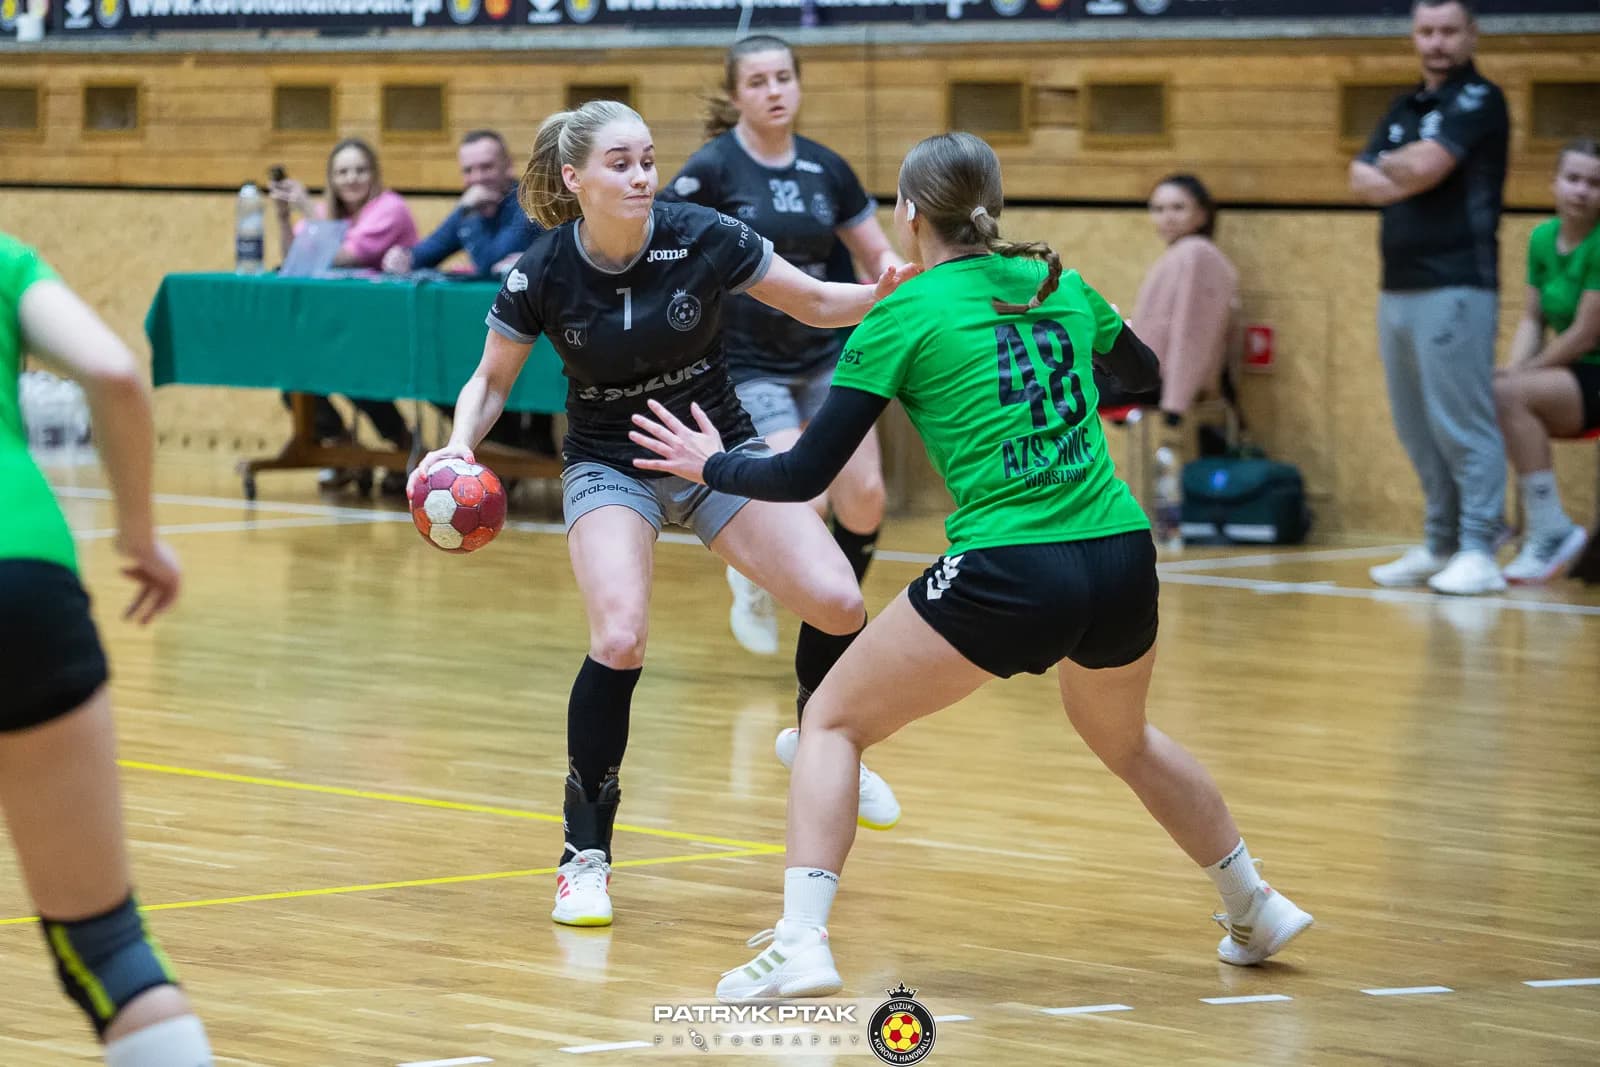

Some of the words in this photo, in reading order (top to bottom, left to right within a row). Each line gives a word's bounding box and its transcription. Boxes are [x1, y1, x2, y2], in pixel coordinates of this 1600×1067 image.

[769, 178, 806, 213] 32
[616, 287, 632, 330] 1
[564, 328, 582, 346] CK
[603, 358, 712, 401] SUZUKI
[994, 319, 1087, 429] 48
[1002, 434, 1050, 480] AZS
[570, 483, 629, 506] karabela
[1024, 467, 1088, 488] WARSZAWA
